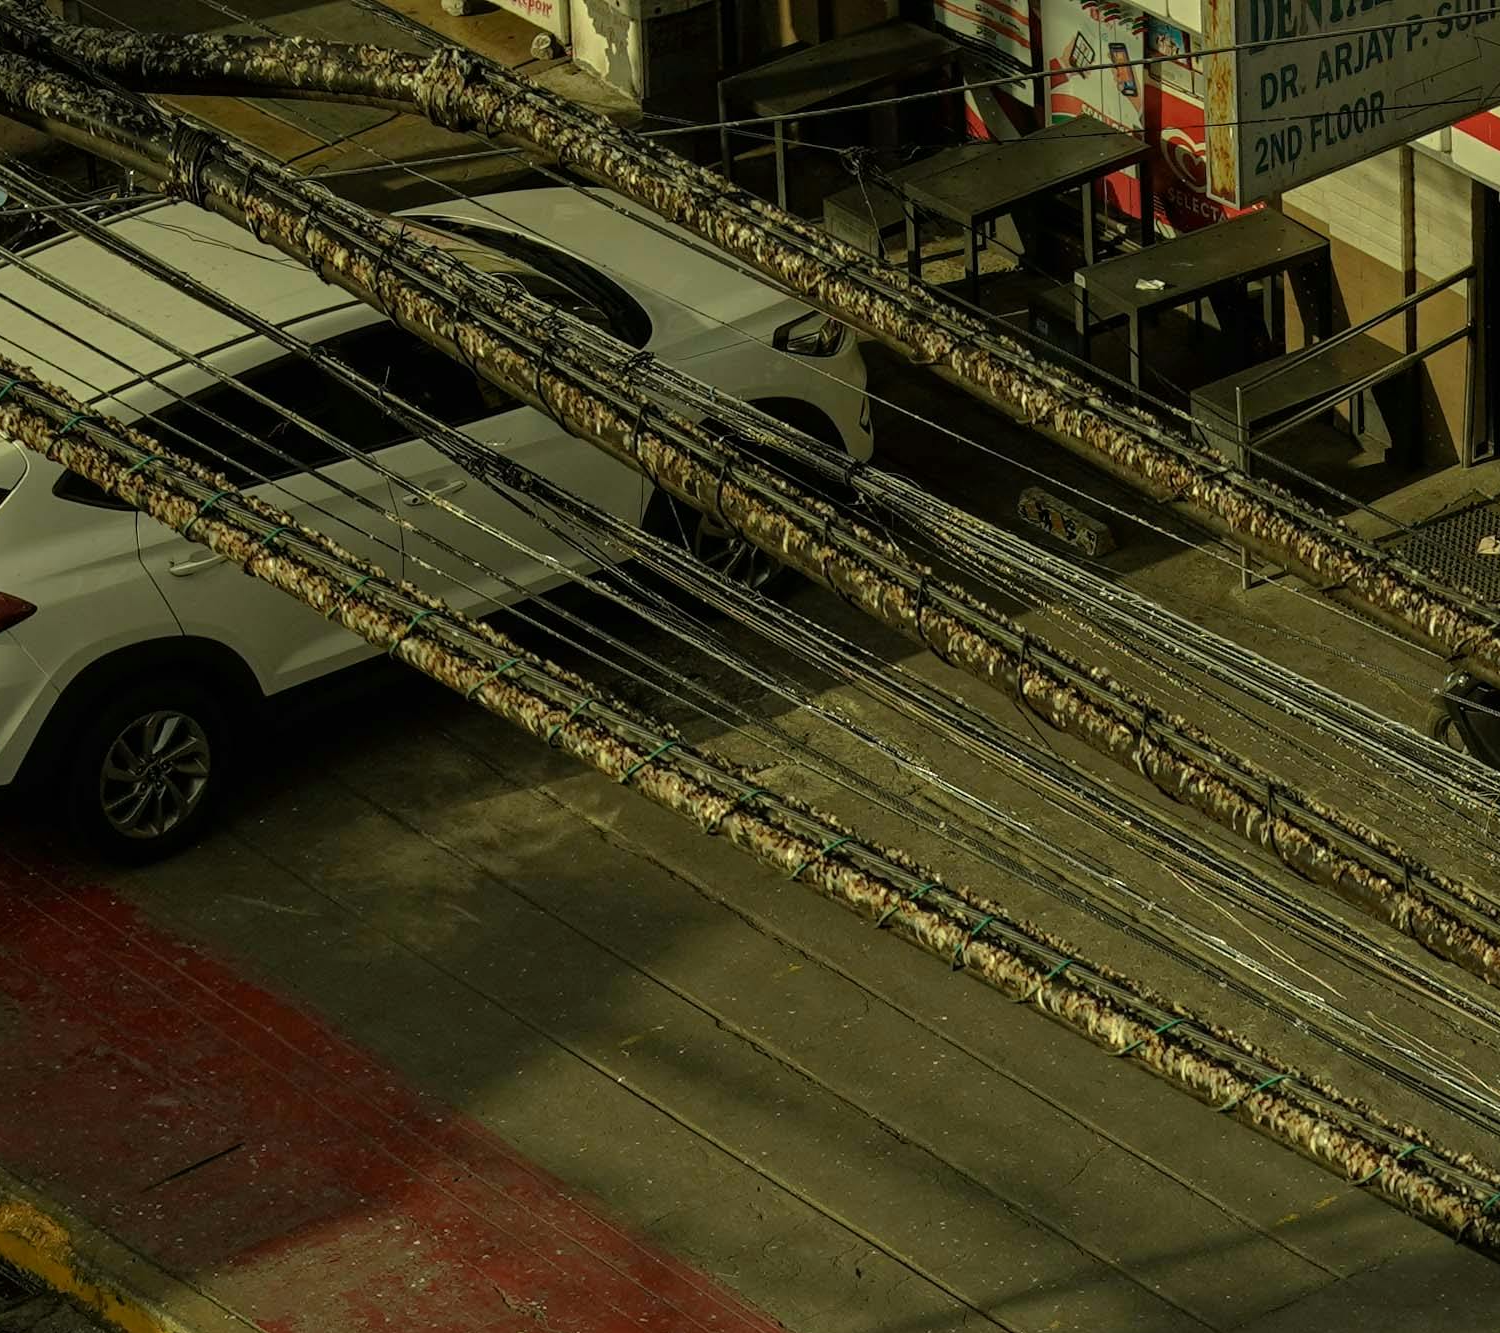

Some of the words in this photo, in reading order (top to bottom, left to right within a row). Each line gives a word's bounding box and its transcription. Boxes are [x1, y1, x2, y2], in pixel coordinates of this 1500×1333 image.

[1260, 63, 1306, 110] DR.
[1316, 27, 1396, 89] ARJAY
[1407, 14, 1428, 51] P.
[1255, 124, 1301, 176] 2ND
[1310, 90, 1386, 152] FLOOR
[1167, 187, 1229, 223] SELECTA
